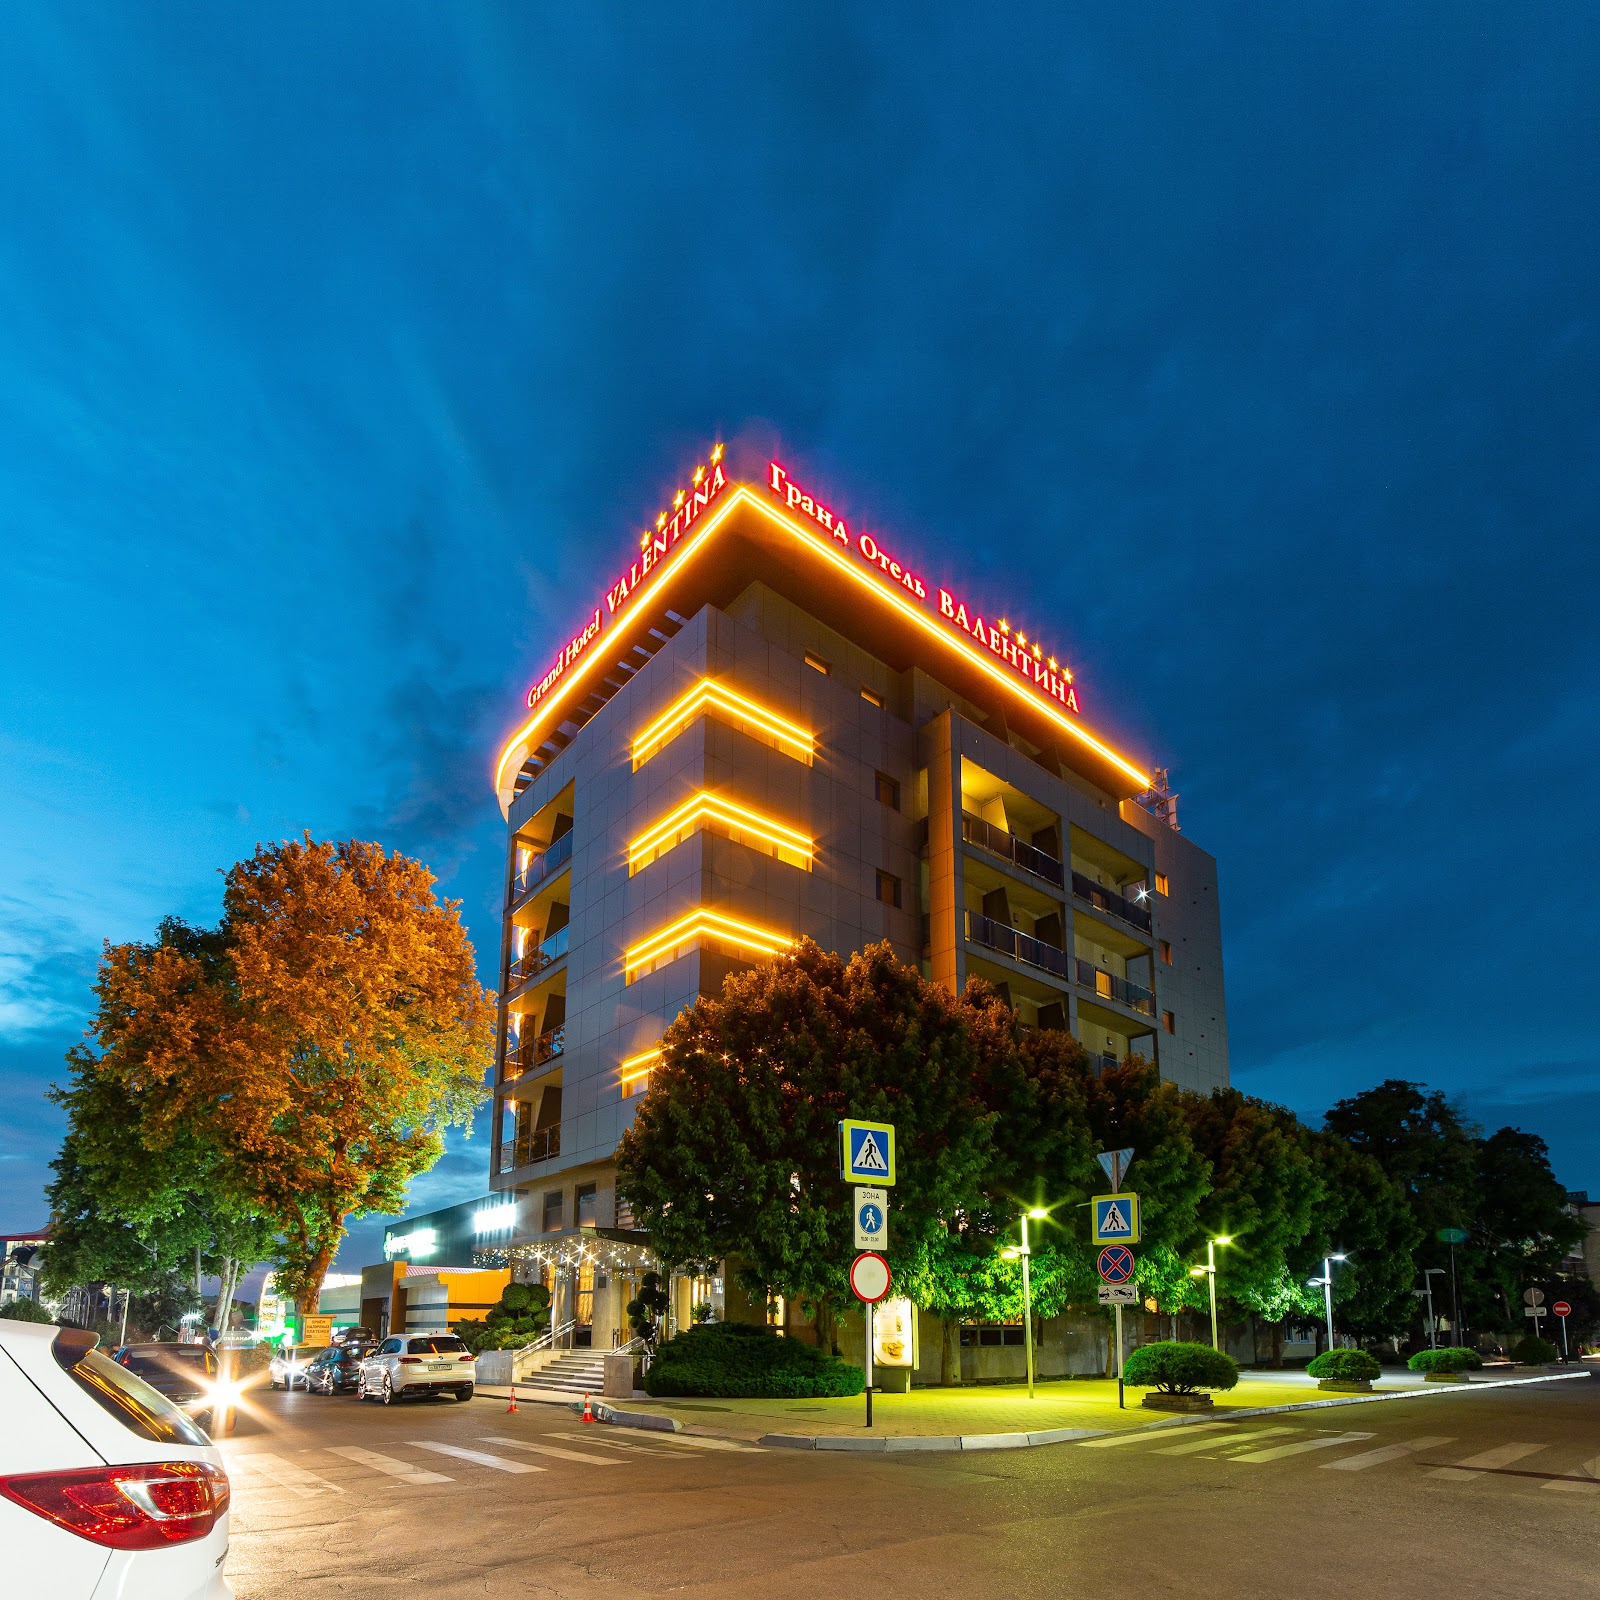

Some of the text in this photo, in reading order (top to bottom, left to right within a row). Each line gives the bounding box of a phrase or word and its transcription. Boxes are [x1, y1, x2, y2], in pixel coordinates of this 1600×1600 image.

[526, 464, 727, 708] Grand Hotel VALENTINA
[770, 462, 1080, 714] Гранд Отель ВАЛЕНТИНА
